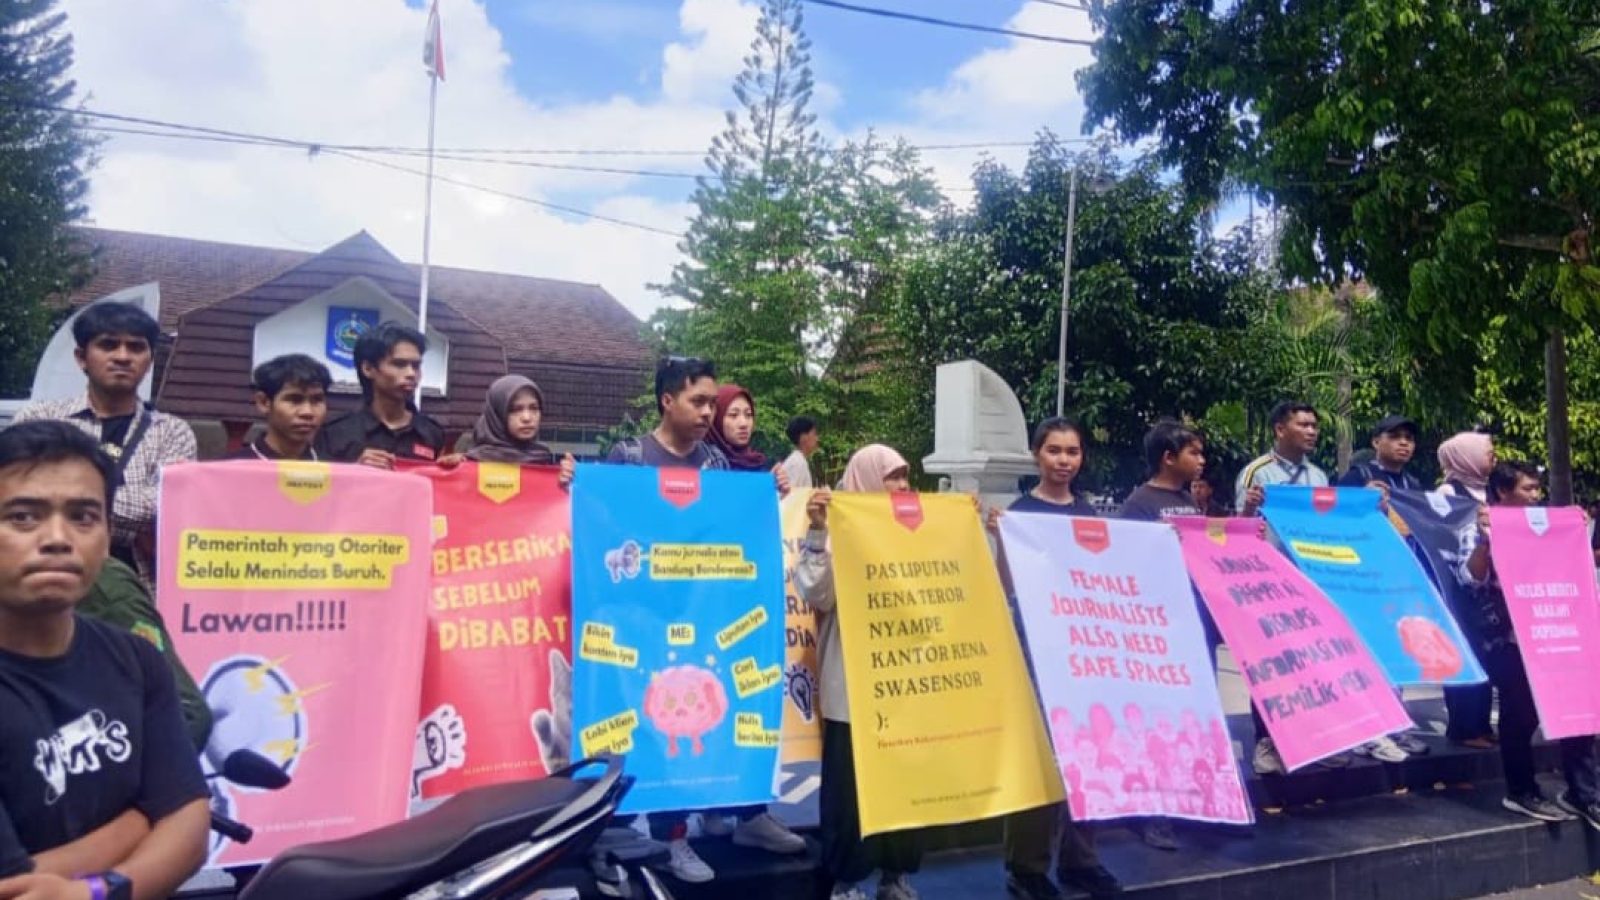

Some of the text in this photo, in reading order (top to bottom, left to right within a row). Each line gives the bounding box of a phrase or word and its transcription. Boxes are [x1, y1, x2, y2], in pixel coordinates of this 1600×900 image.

[187, 534, 404, 557] Pemerintah yang Otoriter
[185, 561, 386, 580] Selalu Menindas Buruh.
[865, 560, 960, 580] PAS LIPUTAN
[1069, 569, 1141, 597] FEMALE
[433, 576, 542, 611] SEBELUM
[867, 587, 965, 610] KENA TEROR
[181, 600, 346, 633] Lawan!!!!!
[869, 616, 944, 639] NYAMPE
[1069, 625, 1168, 655] ALSO NEED
[871, 641, 988, 669] KANTOR KENA
[1069, 653, 1192, 686] SAFE SPACES
[874, 671, 983, 699] SWASENSOR
